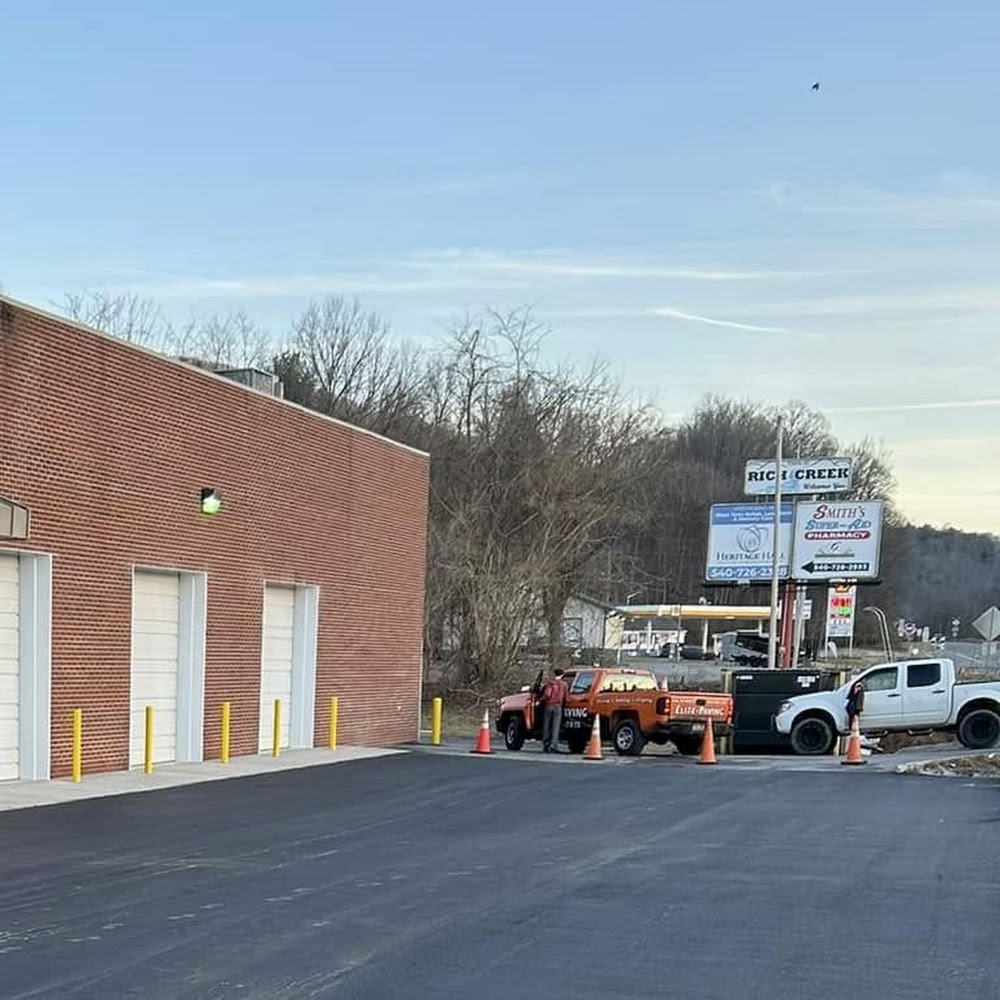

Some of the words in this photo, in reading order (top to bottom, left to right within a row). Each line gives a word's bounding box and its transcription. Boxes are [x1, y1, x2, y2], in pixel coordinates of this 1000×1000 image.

[748, 470, 787, 481] RICH
[795, 468, 849, 480] CREEK
[813, 504, 866, 520] SMITH'S
[807, 532, 867, 540] PHARMACY
[716, 551, 759, 561] HERITAGE
[711, 567, 788, 578] 540-726-238
